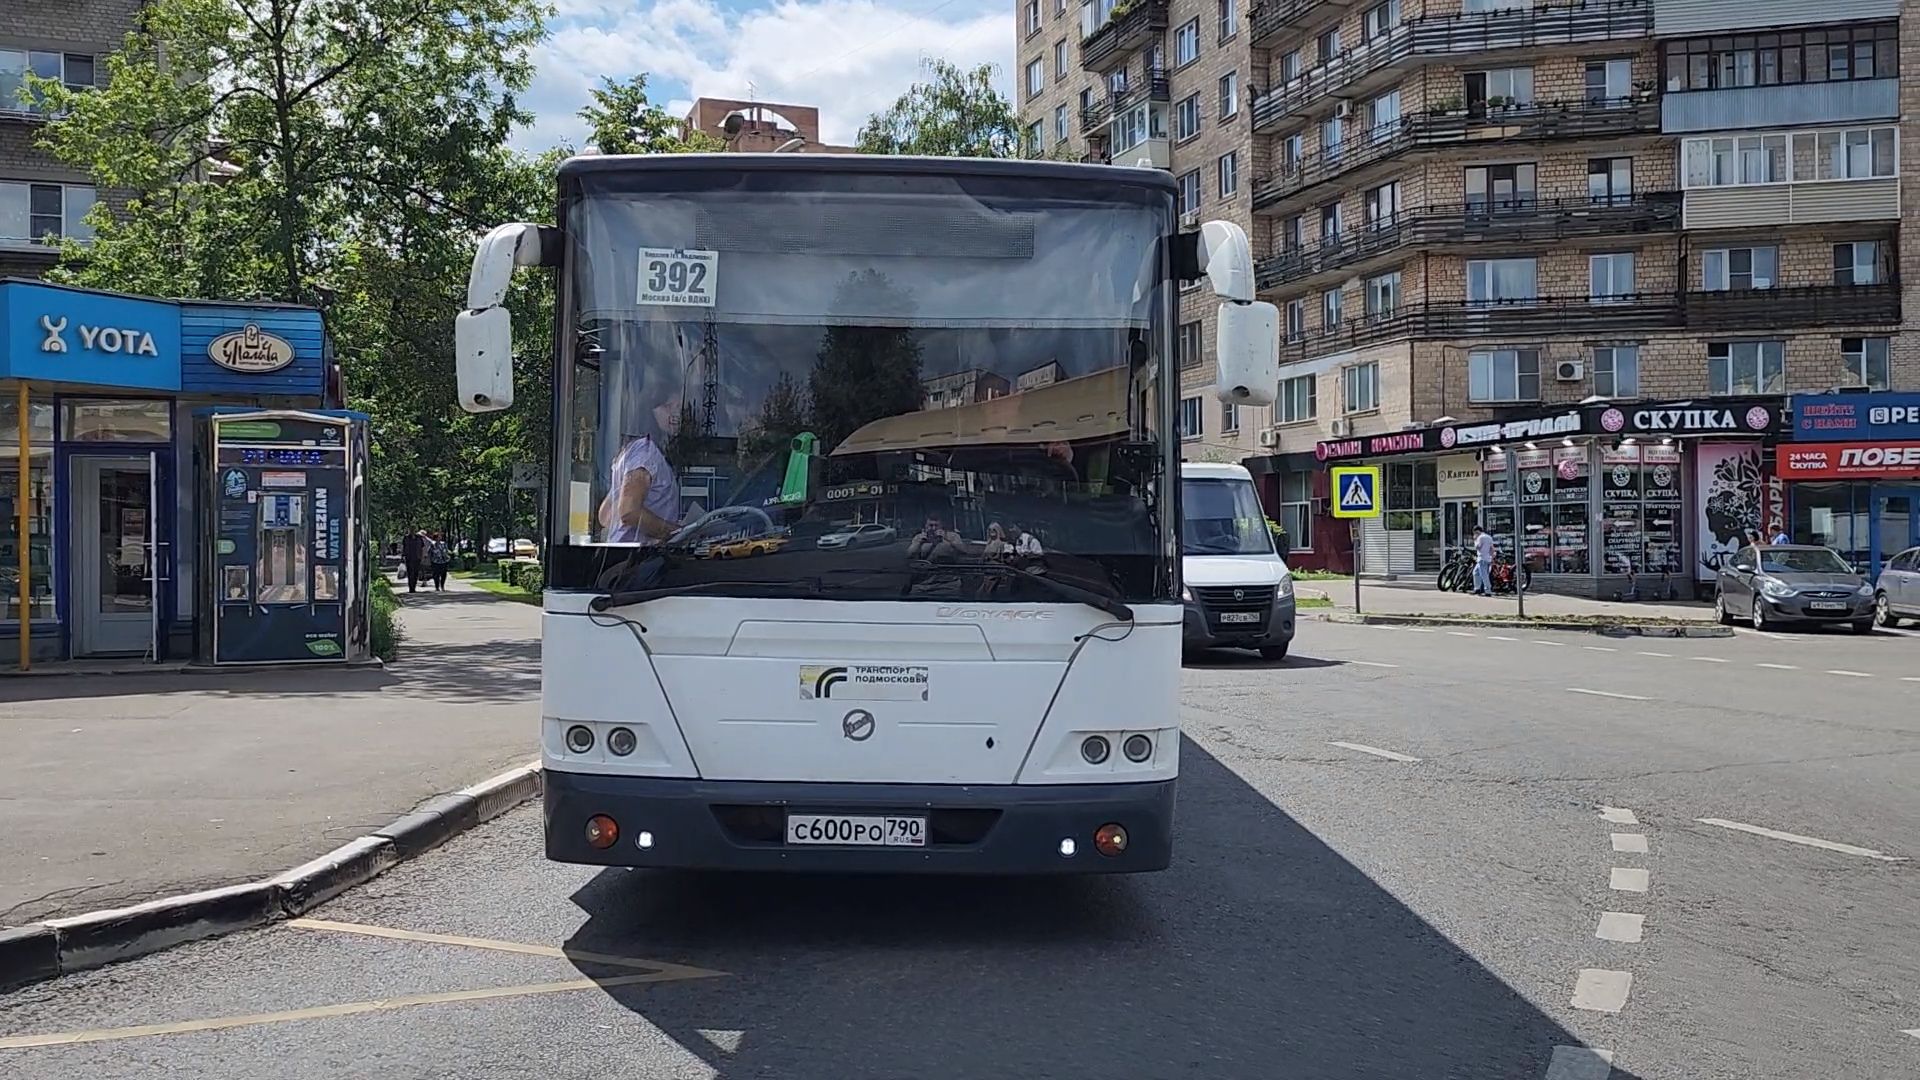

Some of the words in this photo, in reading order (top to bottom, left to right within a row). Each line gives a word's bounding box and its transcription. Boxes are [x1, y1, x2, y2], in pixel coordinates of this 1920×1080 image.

[648, 260, 707, 293] 392
[642, 294, 670, 302] Москва
[79, 324, 159, 357] YOTA
[1633, 409, 1738, 429] СКУПКА
[1801, 418, 1813, 430] С
[1814, 418, 1858, 430] НАМИ
[1370, 433, 1424, 453] КРАСОТЫ
[1789, 453, 1801, 461] 24
[1802, 452, 1828, 461] ЧАСА
[1789, 461, 1828, 470] СКУПКА
[1605, 489, 1638, 498] СКУПКА
[1646, 489, 1679, 497] СКУПКА
[315, 487, 327, 559] ARTEZIAN
[329, 518, 340, 559] WATER
[855, 666, 911, 675] ТРАНСПОРТ
[855, 675, 928, 684] ПОДМОСКОВЬЯ
[886, 819, 920, 837] 790
